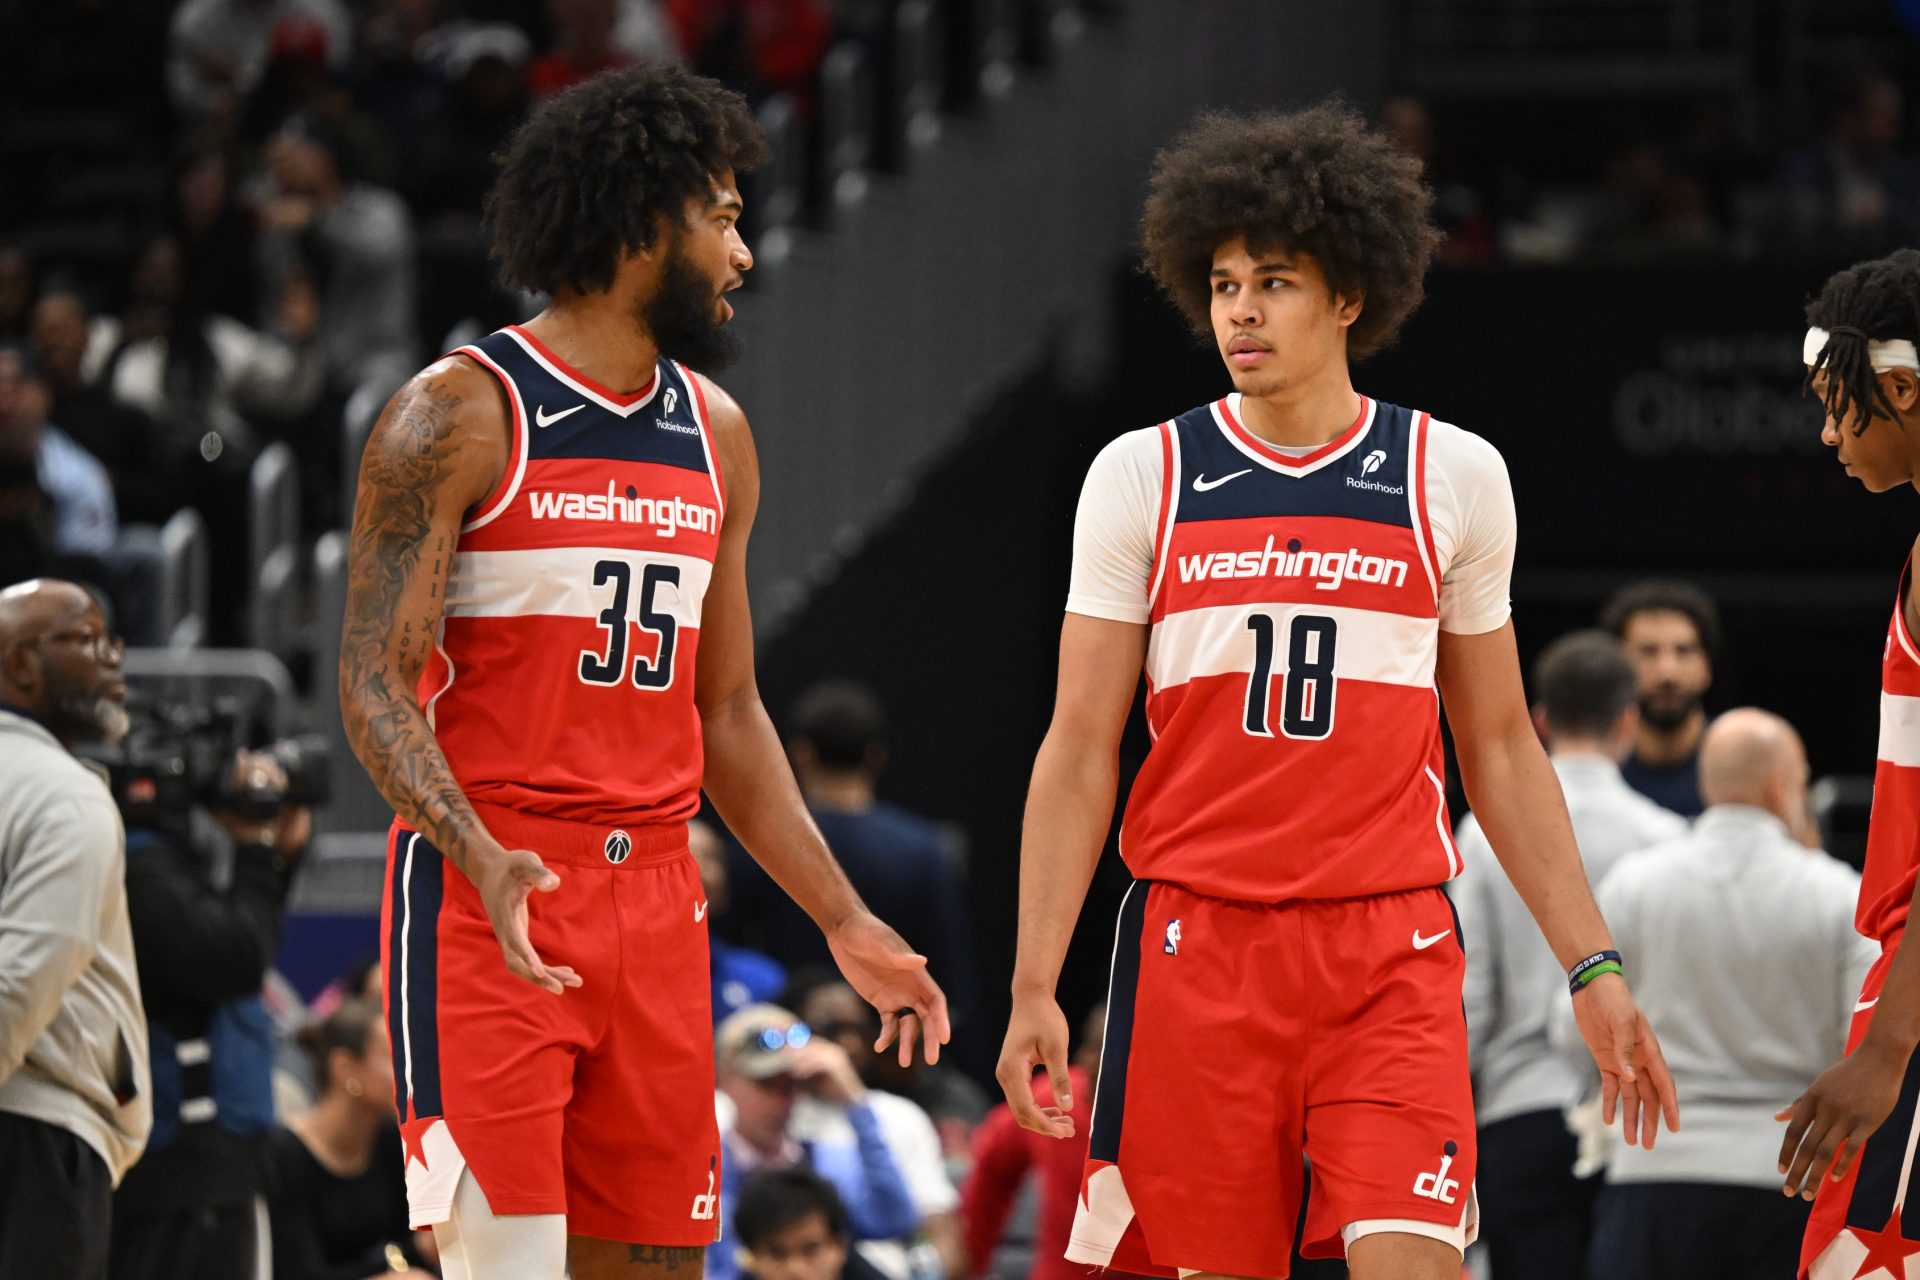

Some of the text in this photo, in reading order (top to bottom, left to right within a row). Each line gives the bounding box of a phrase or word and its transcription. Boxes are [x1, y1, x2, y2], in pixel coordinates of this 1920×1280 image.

[655, 418, 699, 436] Robinhood
[528, 479, 717, 538] washington
[1345, 476, 1404, 495] Robinhood
[1178, 533, 1408, 591] washington
[577, 558, 681, 692] 35
[1242, 612, 1338, 741] 18
